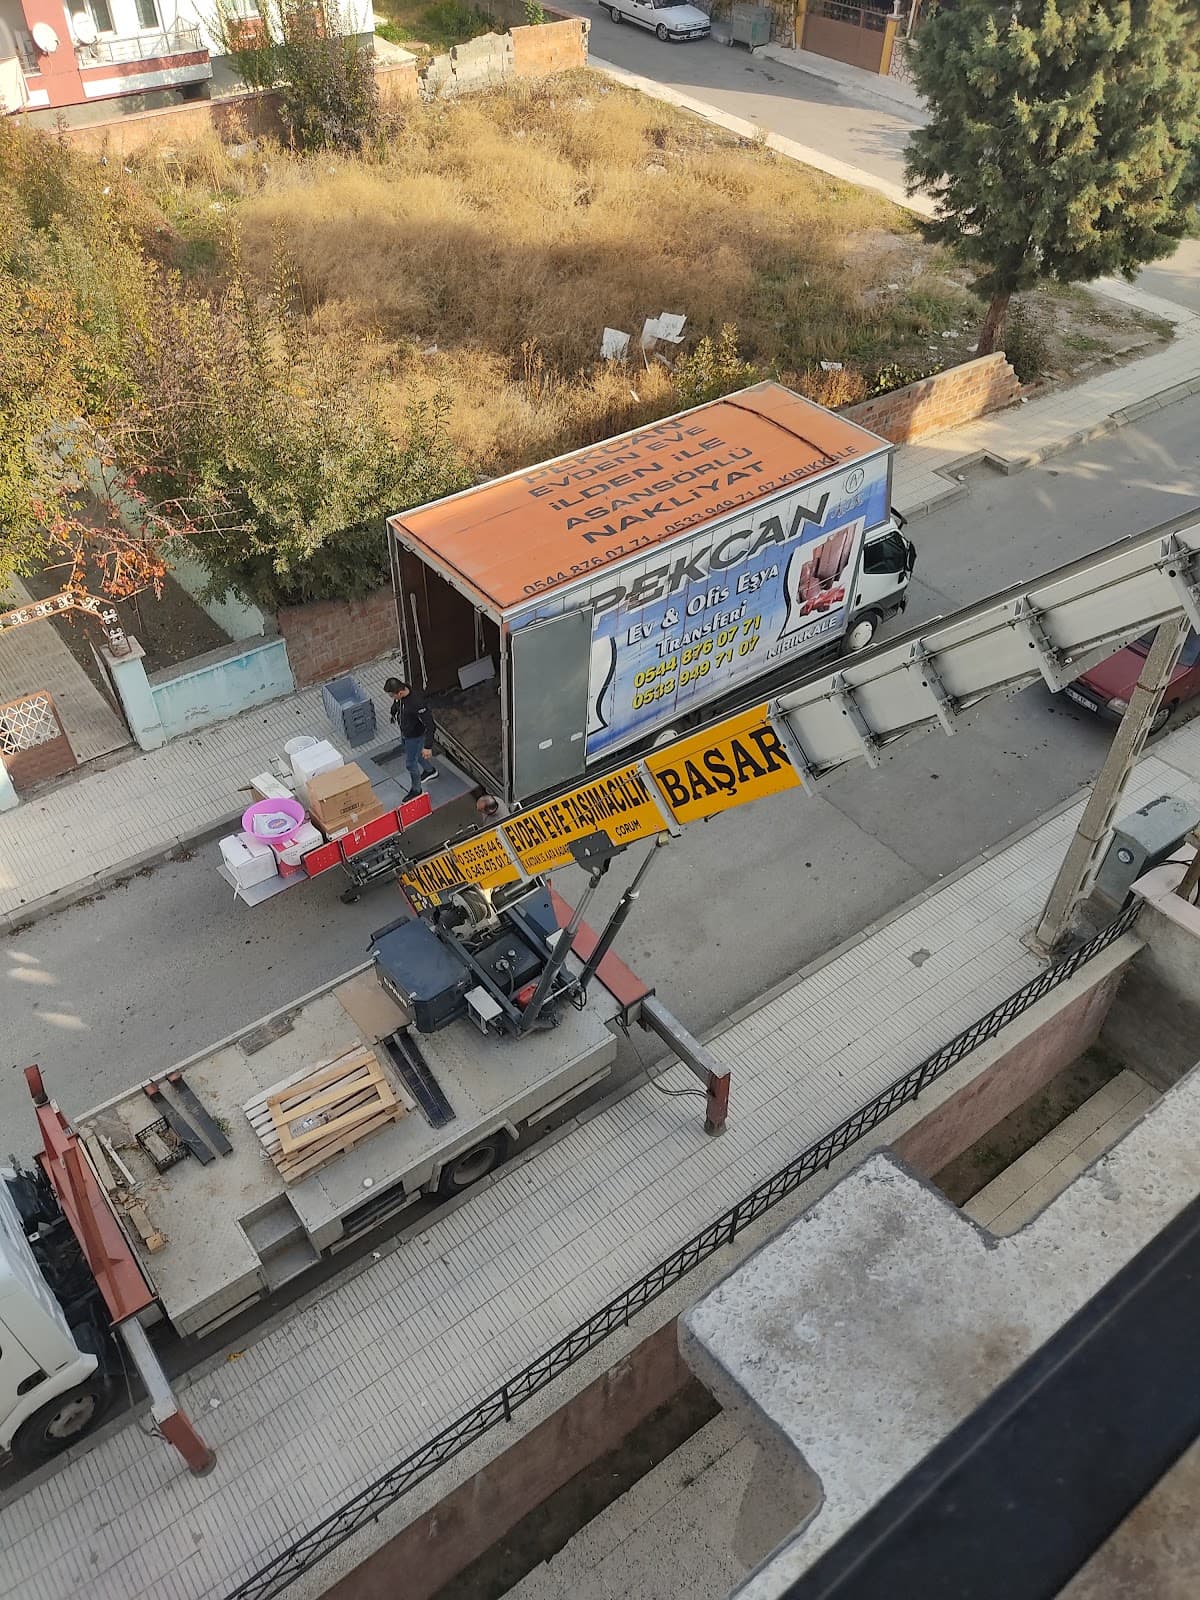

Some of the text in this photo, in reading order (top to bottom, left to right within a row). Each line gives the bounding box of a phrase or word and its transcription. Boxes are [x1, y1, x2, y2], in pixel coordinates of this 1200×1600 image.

[528, 426, 706, 497] EVDEN EVE
[566, 447, 753, 530] ASANSÖRLÜ
[523, 572, 567, 595] 0544
[570, 556, 603, 575] 876
[629, 535, 651, 548] 71
[664, 513, 705, 533] 0533
[736, 490, 755, 501] 71
[778, 445, 859, 483] KIRIKKALE
[582, 491, 830, 611] PEKCAN
[661, 607, 679, 629] &
[687, 585, 730, 616] Ofis
[632, 636, 759, 710] 0533 949 71 07
[634, 615, 762, 688] 0544 876 07 71
[656, 725, 792, 808] BAŞAR
[505, 814, 548, 852] EVDEN
[539, 804, 572, 839] EVE
[615, 819, 642, 838] ÇORUM
